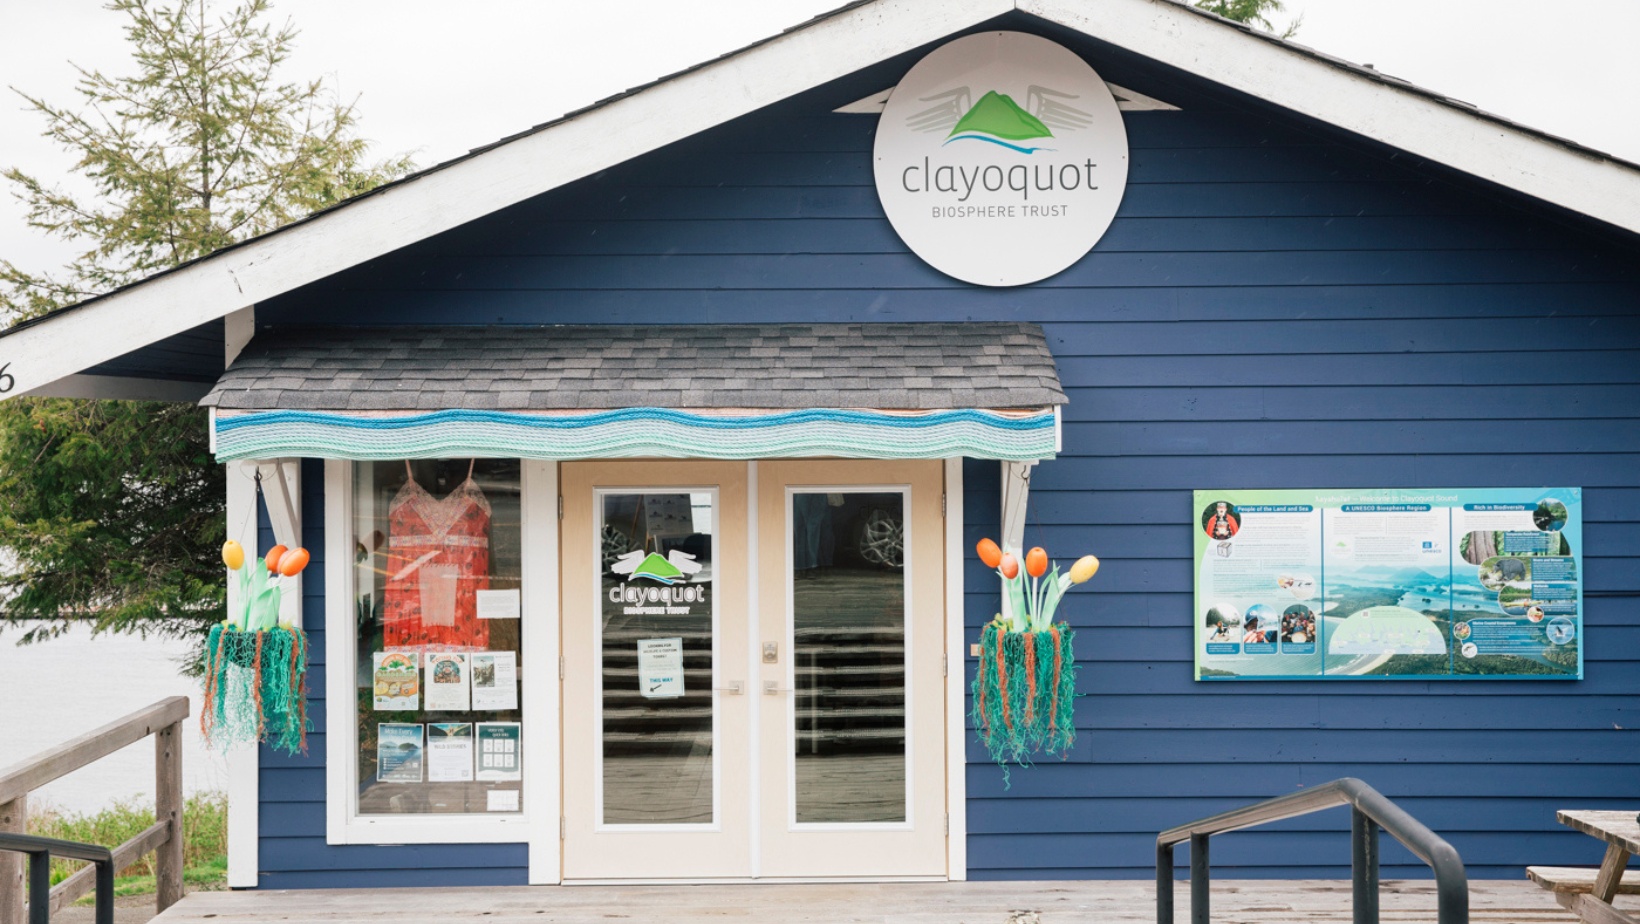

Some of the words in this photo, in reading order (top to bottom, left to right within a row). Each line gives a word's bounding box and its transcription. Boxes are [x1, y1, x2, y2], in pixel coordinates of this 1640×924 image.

[902, 156, 1099, 202] clayoquot
[932, 206, 1016, 218] BIOSPHERE
[1021, 205, 1068, 217] TRUST
[0, 361, 15, 393] 6
[1400, 495, 1434, 503] Clayoquot
[1435, 494, 1458, 502] Sound
[608, 582, 705, 607] clayoquot
[623, 606, 665, 615] BIOSPHERE
[666, 606, 691, 615] TRUST
[399, 728, 413, 736] Every
